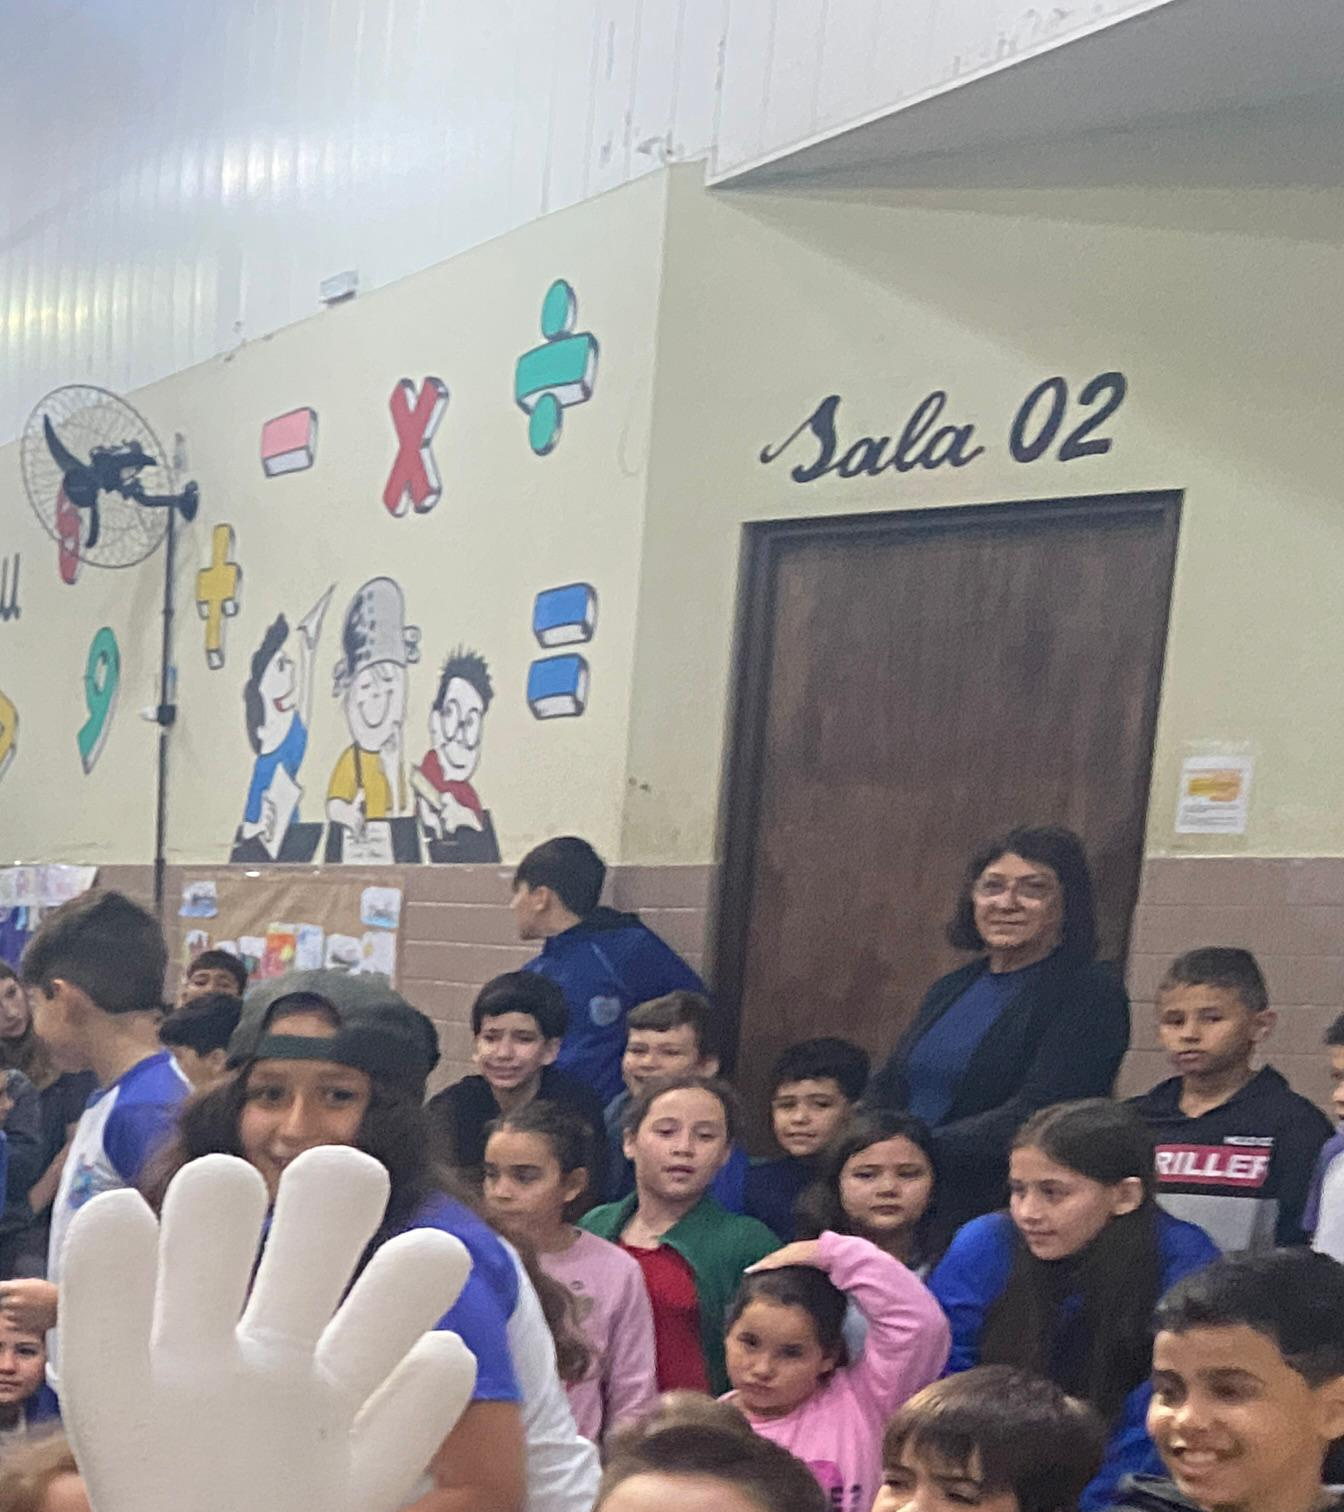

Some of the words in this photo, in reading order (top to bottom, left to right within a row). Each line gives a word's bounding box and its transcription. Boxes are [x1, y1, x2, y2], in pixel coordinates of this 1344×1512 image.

[760, 390, 985, 483] Sala
[1009, 372, 1128, 463] 02
[77, 626, 120, 775] 9
